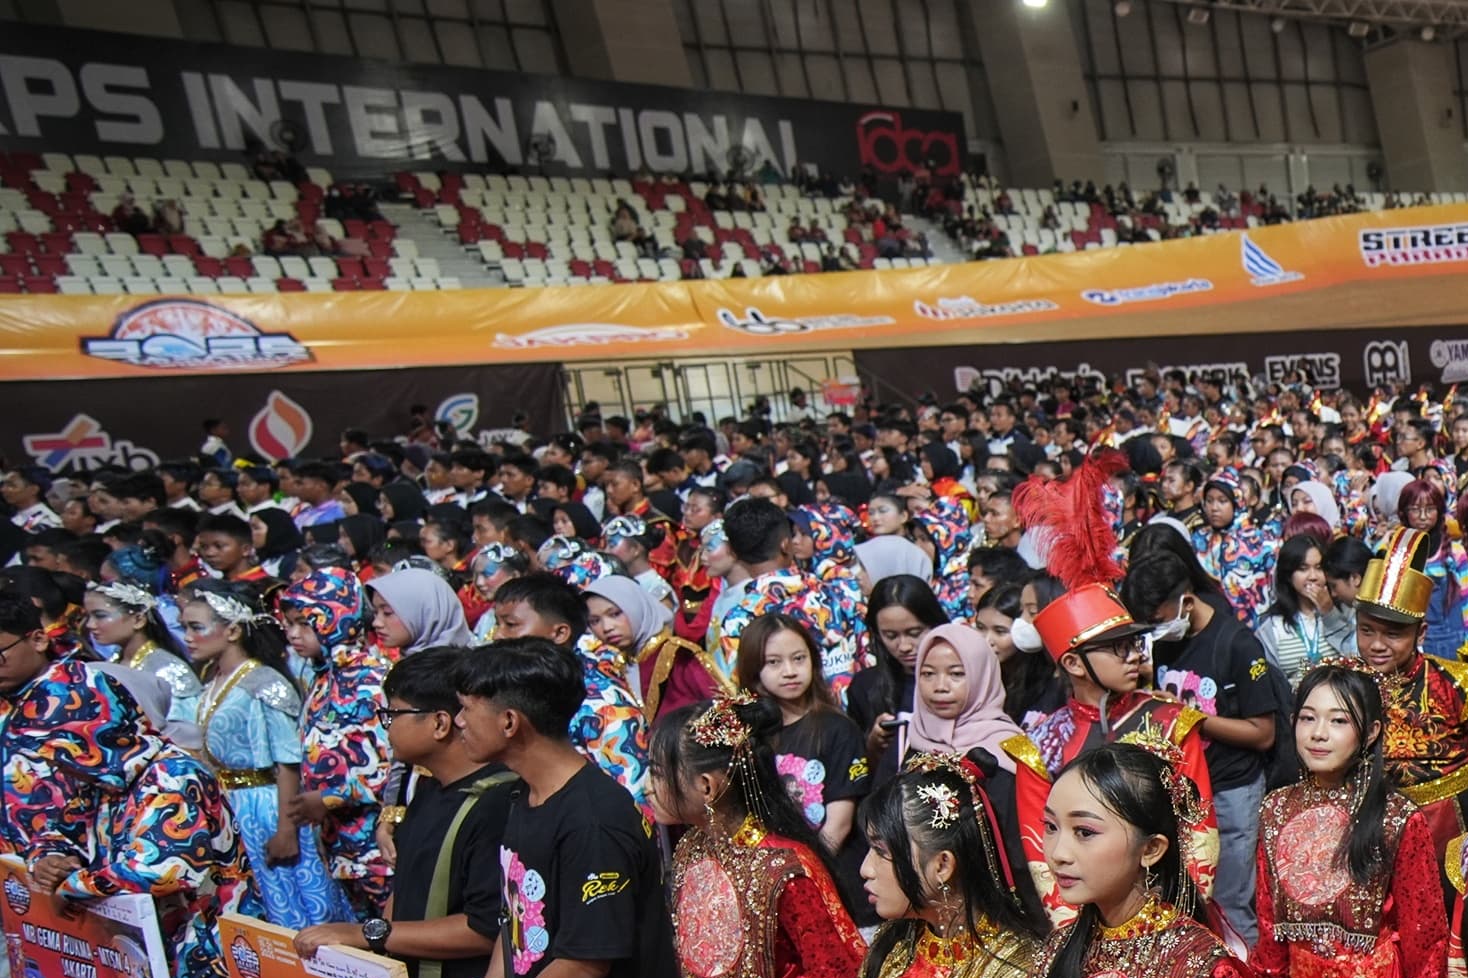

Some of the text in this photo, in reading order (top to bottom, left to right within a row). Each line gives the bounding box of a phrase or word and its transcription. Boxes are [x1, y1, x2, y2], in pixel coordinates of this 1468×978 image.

[0, 54, 818, 178] PS INTERNATIONAL
[36, 926, 61, 950] GEMA
